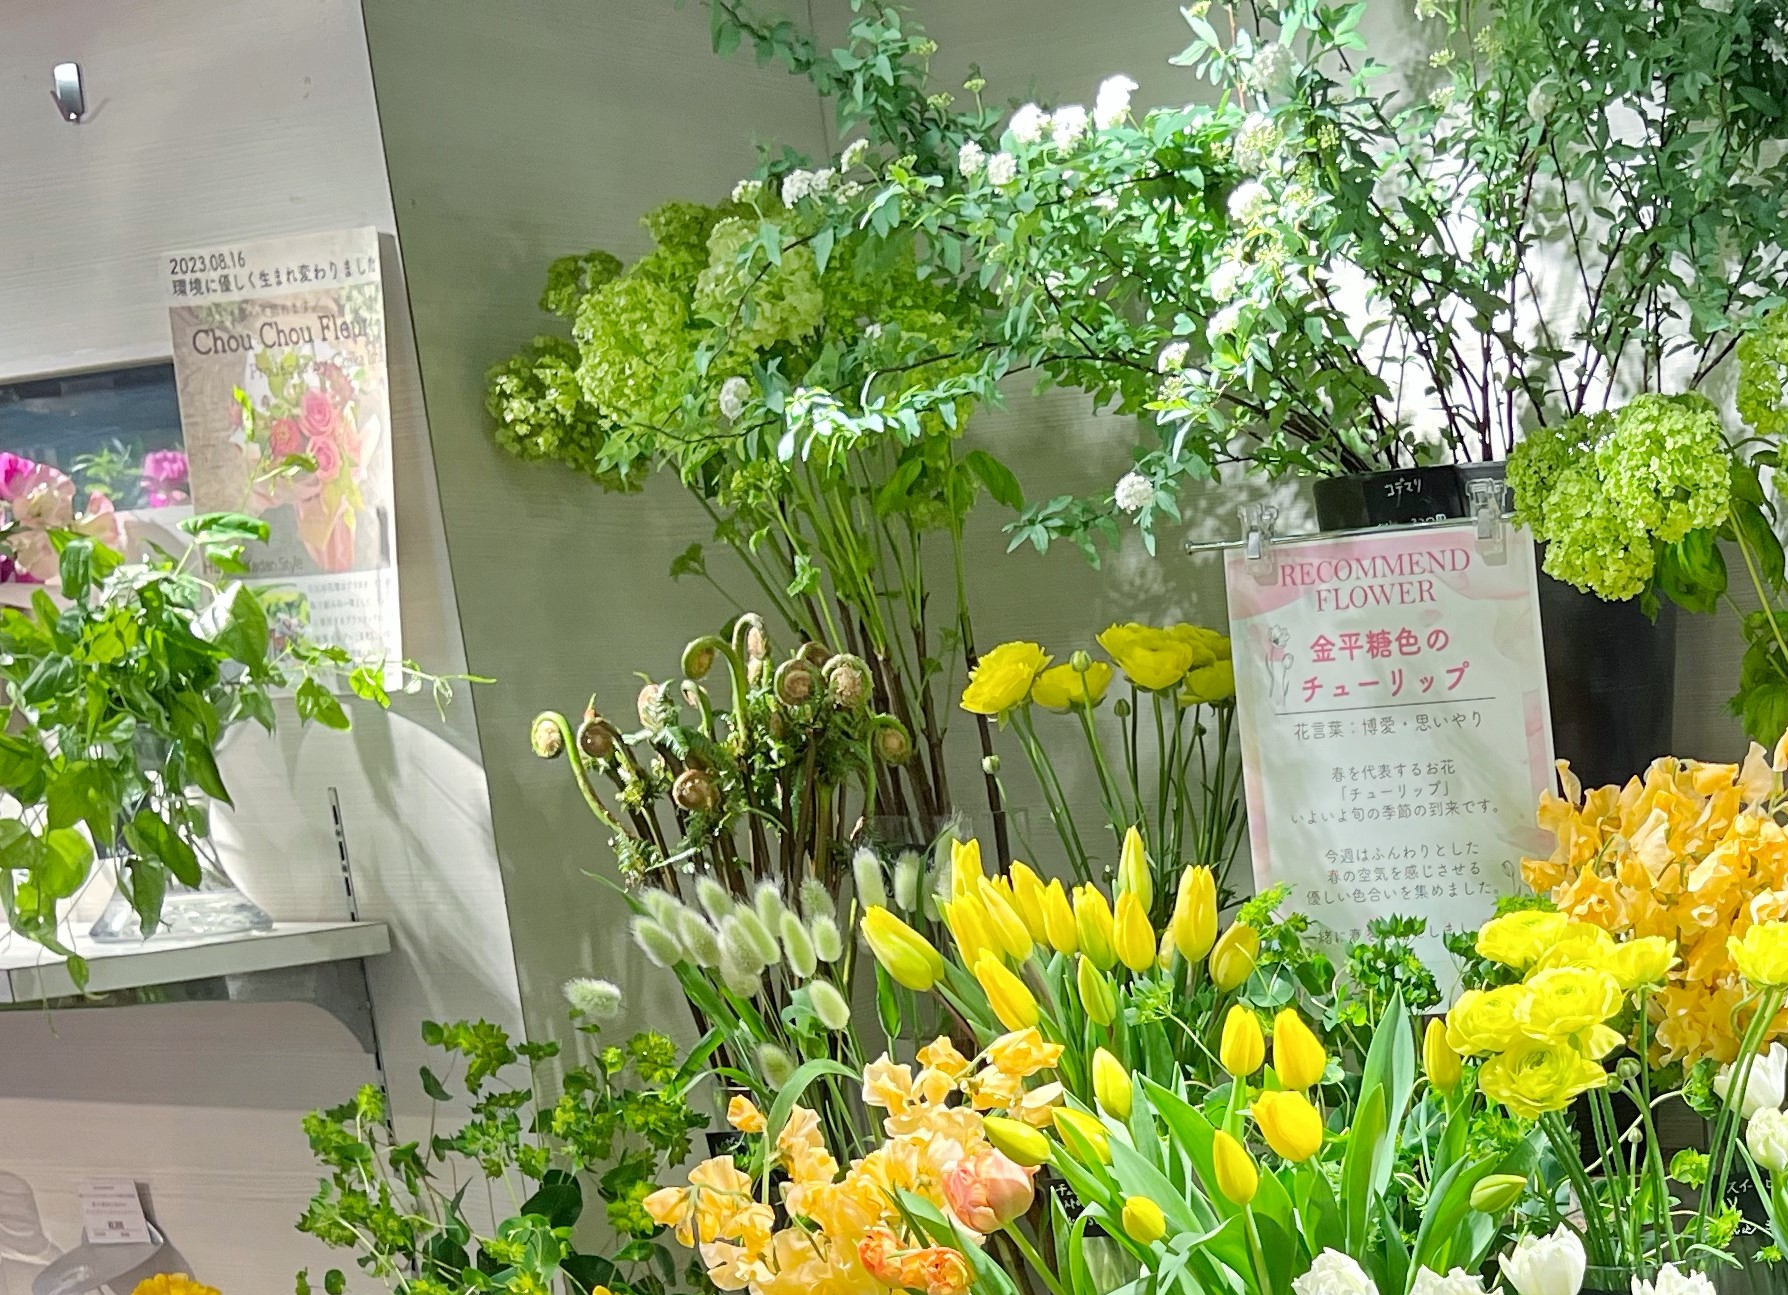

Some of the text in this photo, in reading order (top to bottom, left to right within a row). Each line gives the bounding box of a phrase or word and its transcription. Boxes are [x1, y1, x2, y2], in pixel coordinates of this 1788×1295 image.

[170, 251, 246, 275] 2023.08.16
[172, 256, 377, 297] 環境に優しく生まれ変わりました
[192, 313, 369, 356] Chou Chou Fleur
[1384, 477, 1423, 498] コデマリ
[1280, 547, 1471, 588] RECOMMEND
[1315, 579, 1437, 613] FLOWER
[1309, 626, 1450, 664] 金平糖色の
[1301, 660, 1471, 704] チューリップ
[1331, 758, 1457, 783] 春を代表するお花
[1341, 780, 1450, 802] 「チューリップ」
[1290, 798, 1499, 825] いよいよ旬の季節の到来です。
[1324, 840, 1480, 864] 今週はふんわりとした
[1327, 862, 1481, 884] 春の空気を感じさせる
[1306, 882, 1499, 906] 優しい色合いを集めました。
